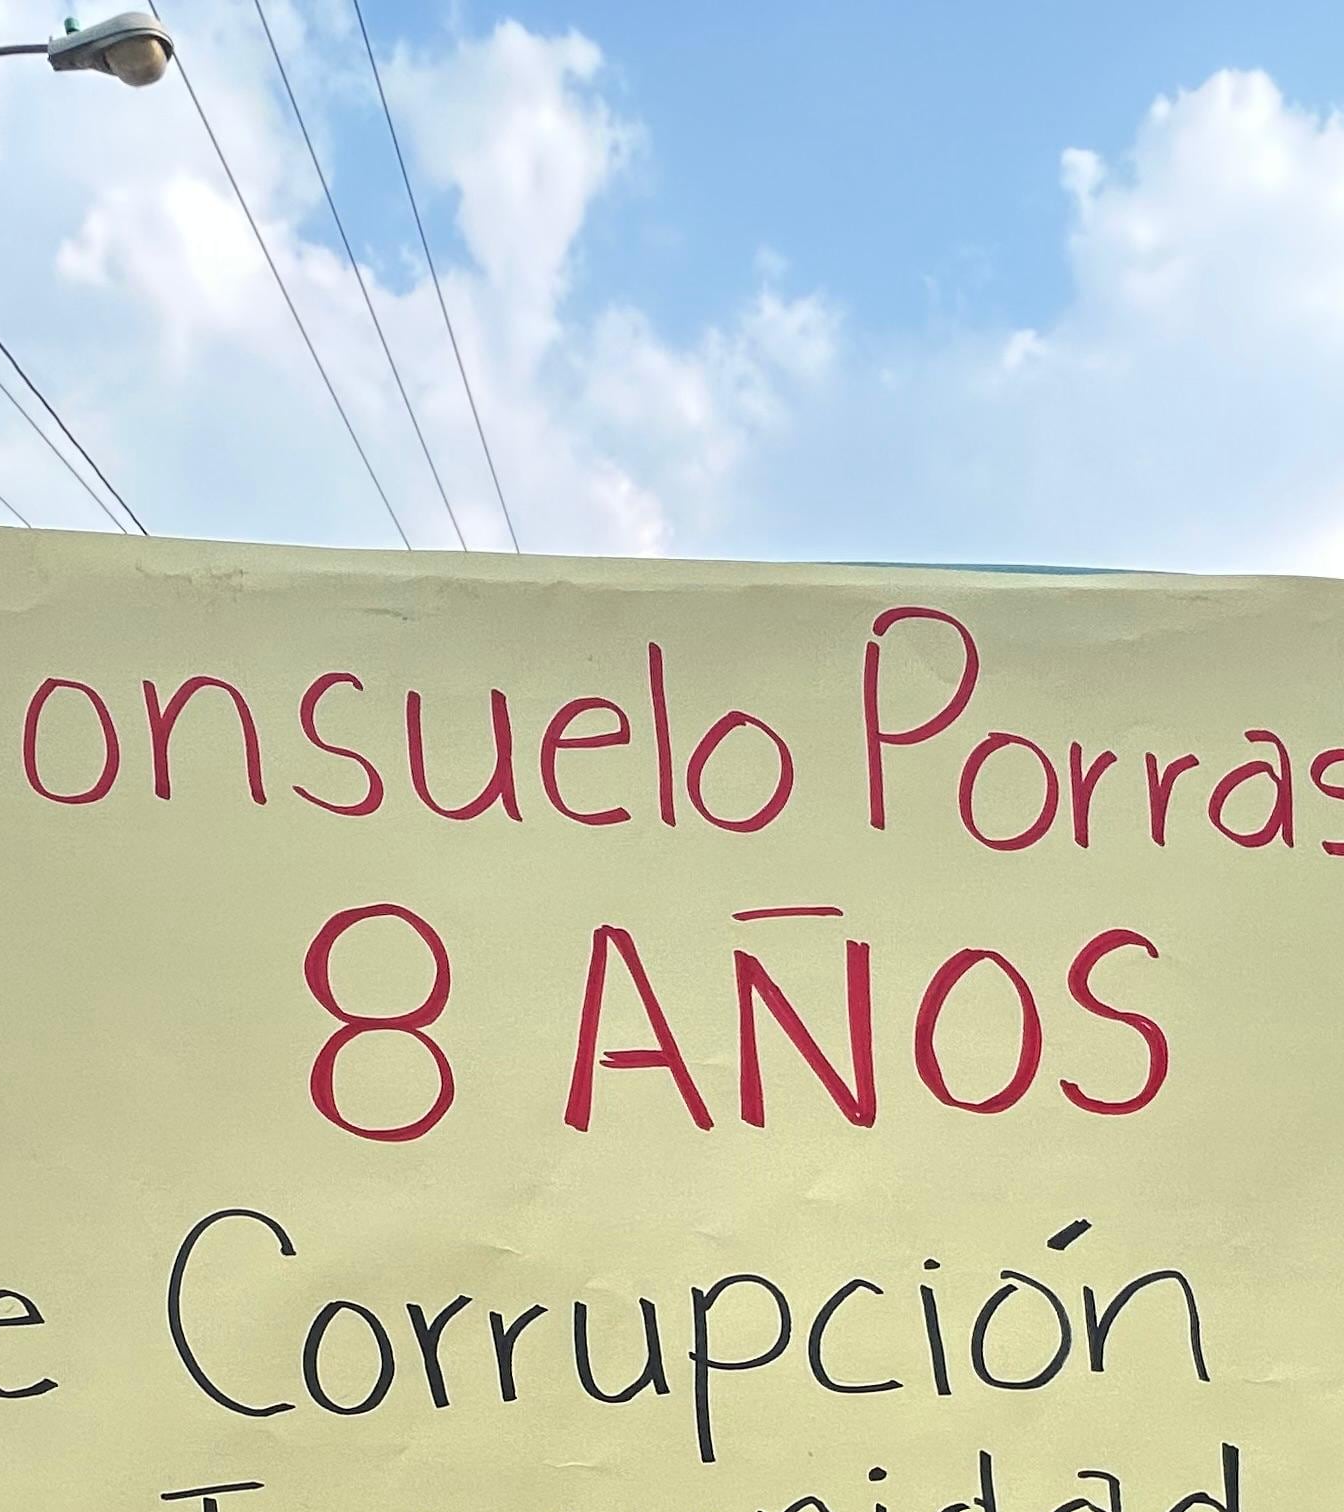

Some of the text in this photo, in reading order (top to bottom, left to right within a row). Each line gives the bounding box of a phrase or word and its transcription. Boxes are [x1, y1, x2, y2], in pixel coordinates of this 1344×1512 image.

[304, 903, 1170, 1142] 8 AÑOS
[166, 1207, 1213, 1464] Corrupción
